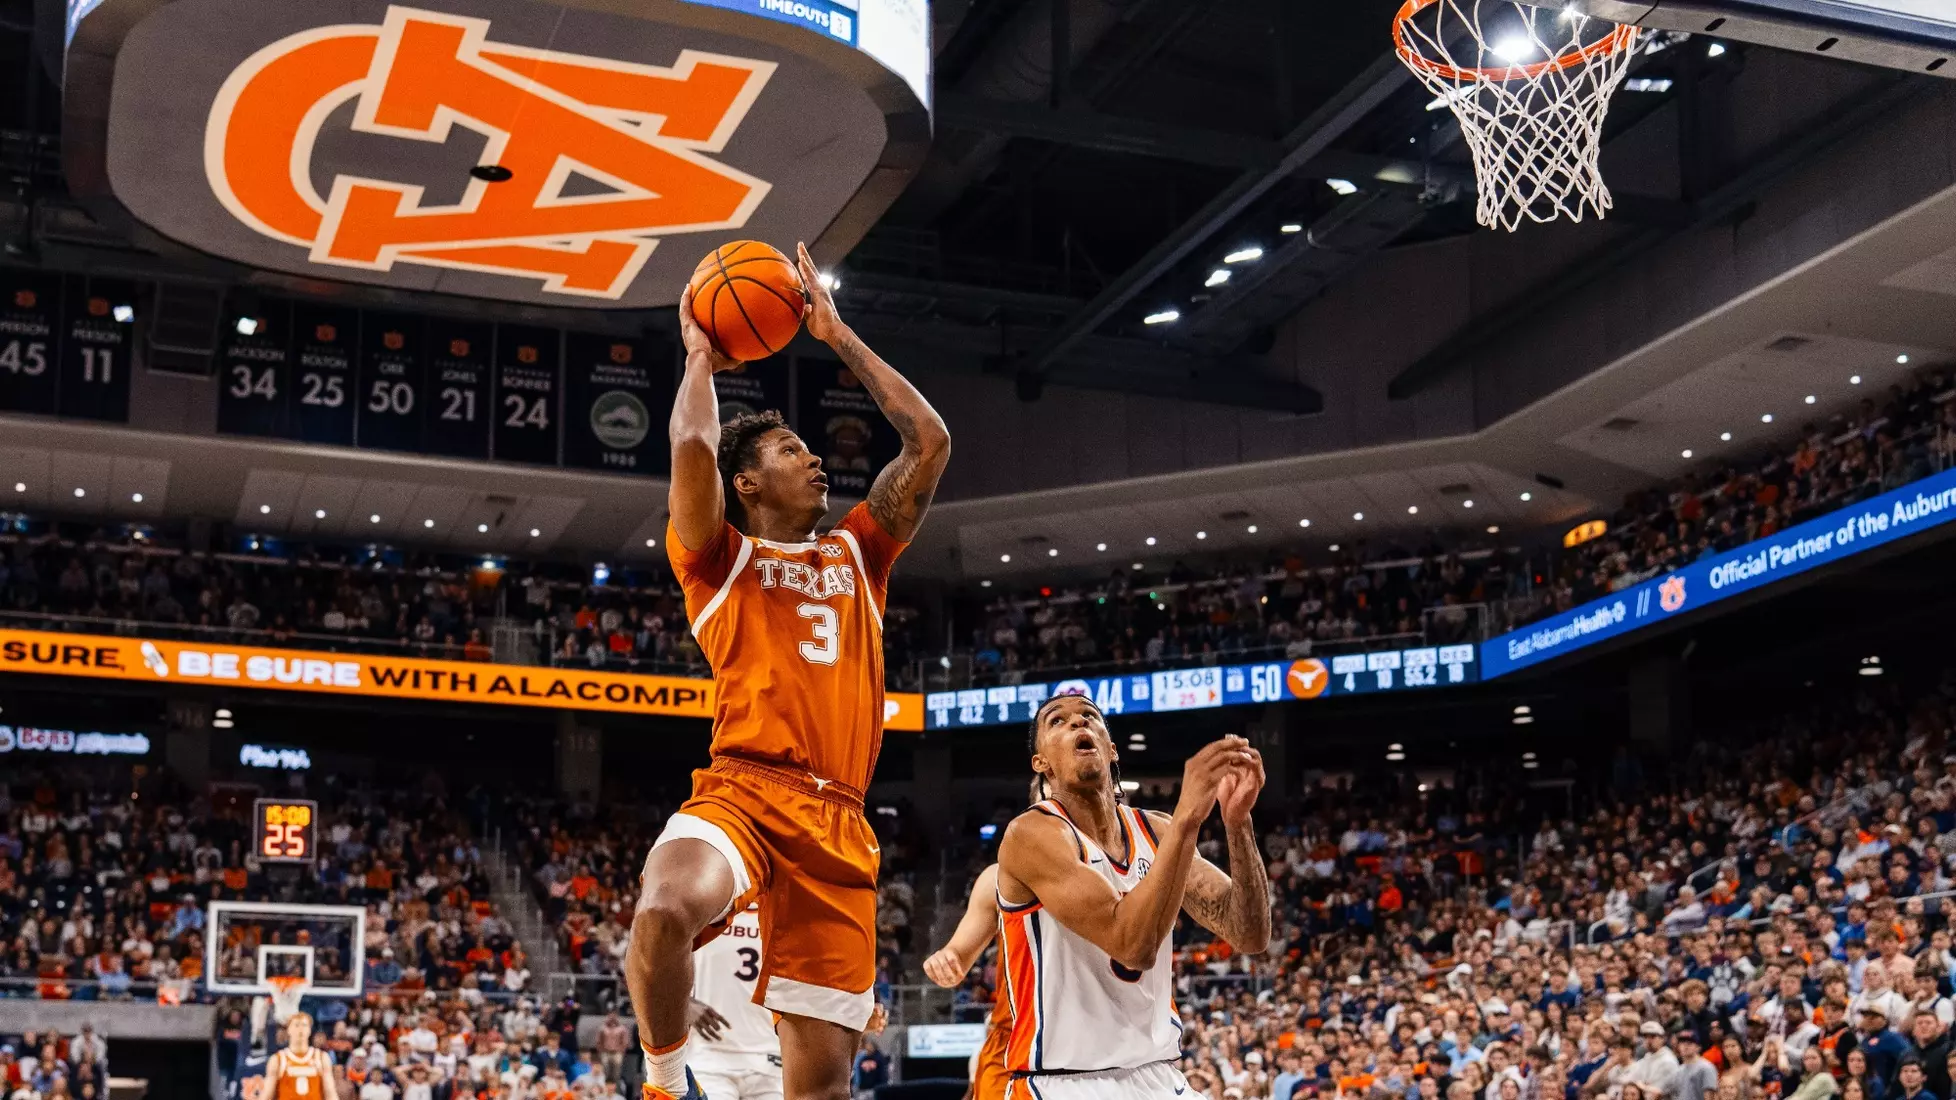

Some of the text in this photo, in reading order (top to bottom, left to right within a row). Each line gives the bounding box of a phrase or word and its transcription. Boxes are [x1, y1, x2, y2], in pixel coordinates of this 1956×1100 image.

[759, 0, 829, 27] TIMEOUTS
[0, 339, 47, 376] 45
[80, 346, 113, 384] 11
[229, 364, 278, 401] 34
[301, 372, 346, 408] 25
[368, 380, 414, 415] 50
[440, 386, 476, 422] 21
[504, 394, 550, 430] 24
[820, 544, 844, 557] SEC
[1709, 551, 1767, 590] Official
[1770, 531, 1834, 569] Partner
[1836, 517, 1856, 545] of
[1857, 512, 1888, 538] the
[755, 558, 856, 600] TEXAS
[797, 602, 840, 666] 3
[3, 641, 707, 709] SURE, BE SURE WITH ALACOMP!
[1251, 665, 1282, 702] 50
[1097, 679, 1124, 714] 44
[264, 824, 304, 855] 25
[734, 947, 760, 982] 3
